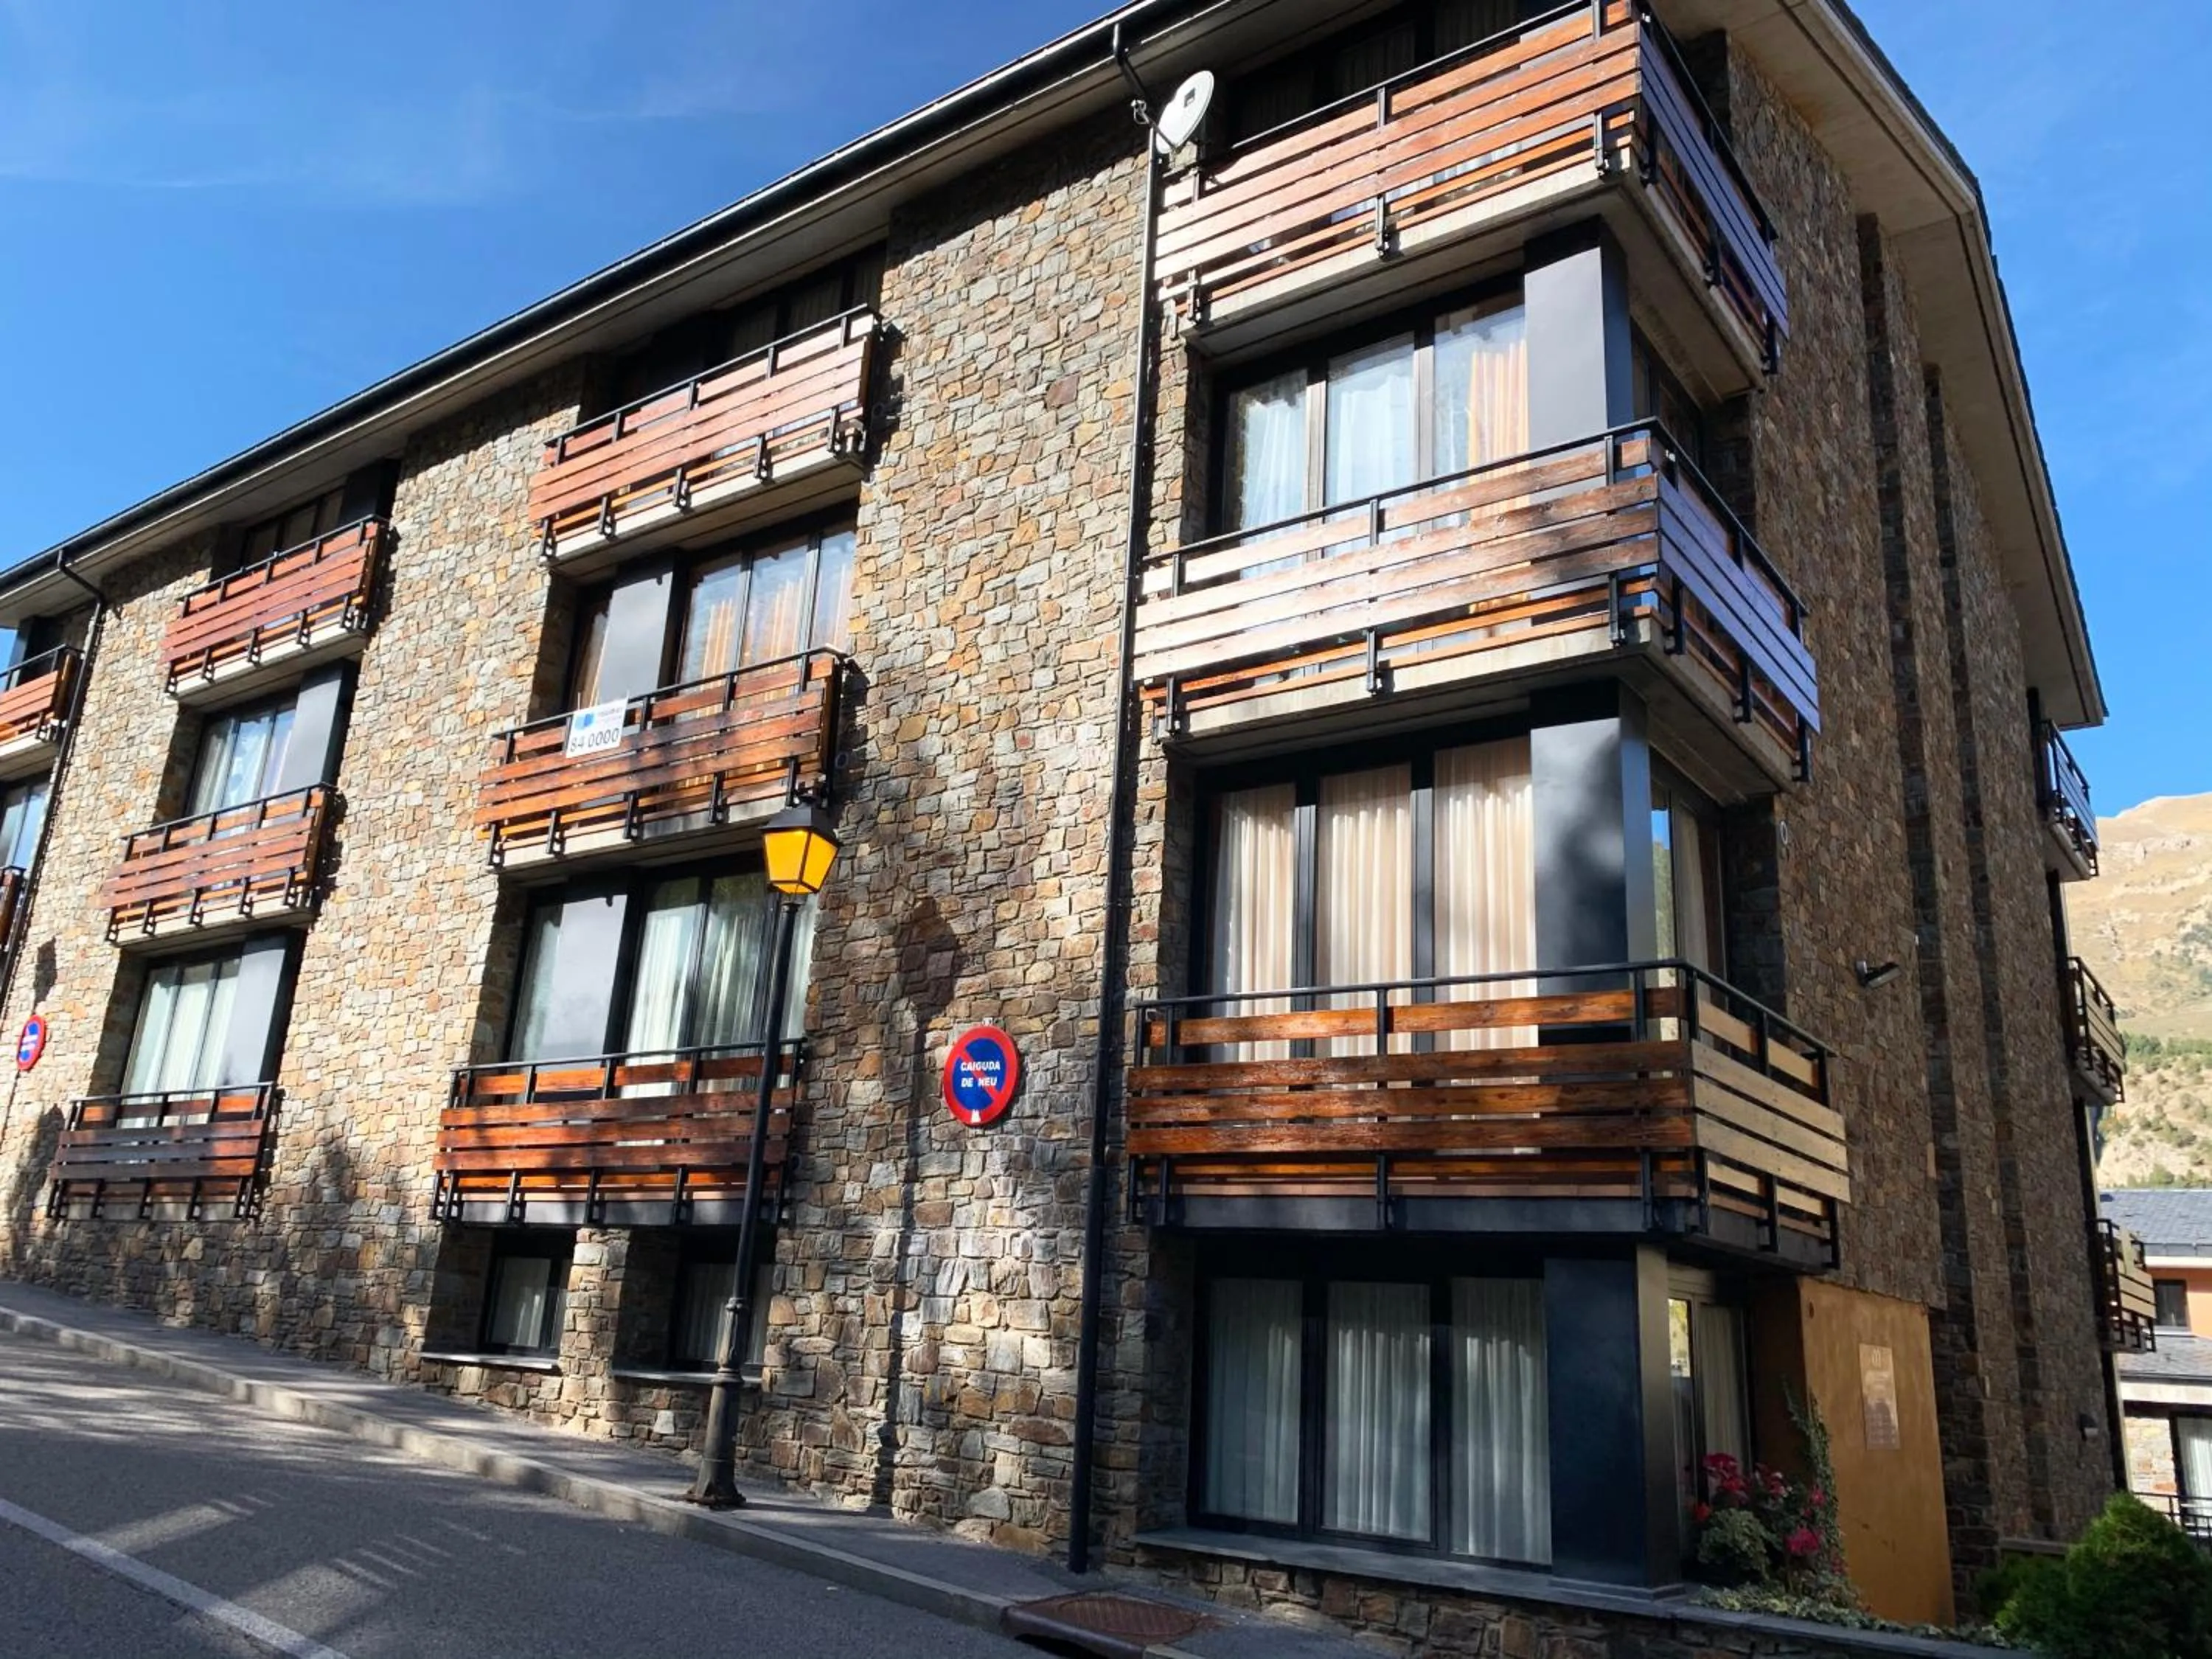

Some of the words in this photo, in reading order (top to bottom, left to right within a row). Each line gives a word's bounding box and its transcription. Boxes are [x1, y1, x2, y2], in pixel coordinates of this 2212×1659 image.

[961, 1060, 1001, 1071] CAIGUDA
[961, 1077, 973, 1088] DE
[978, 1077, 998, 1087] NEU
